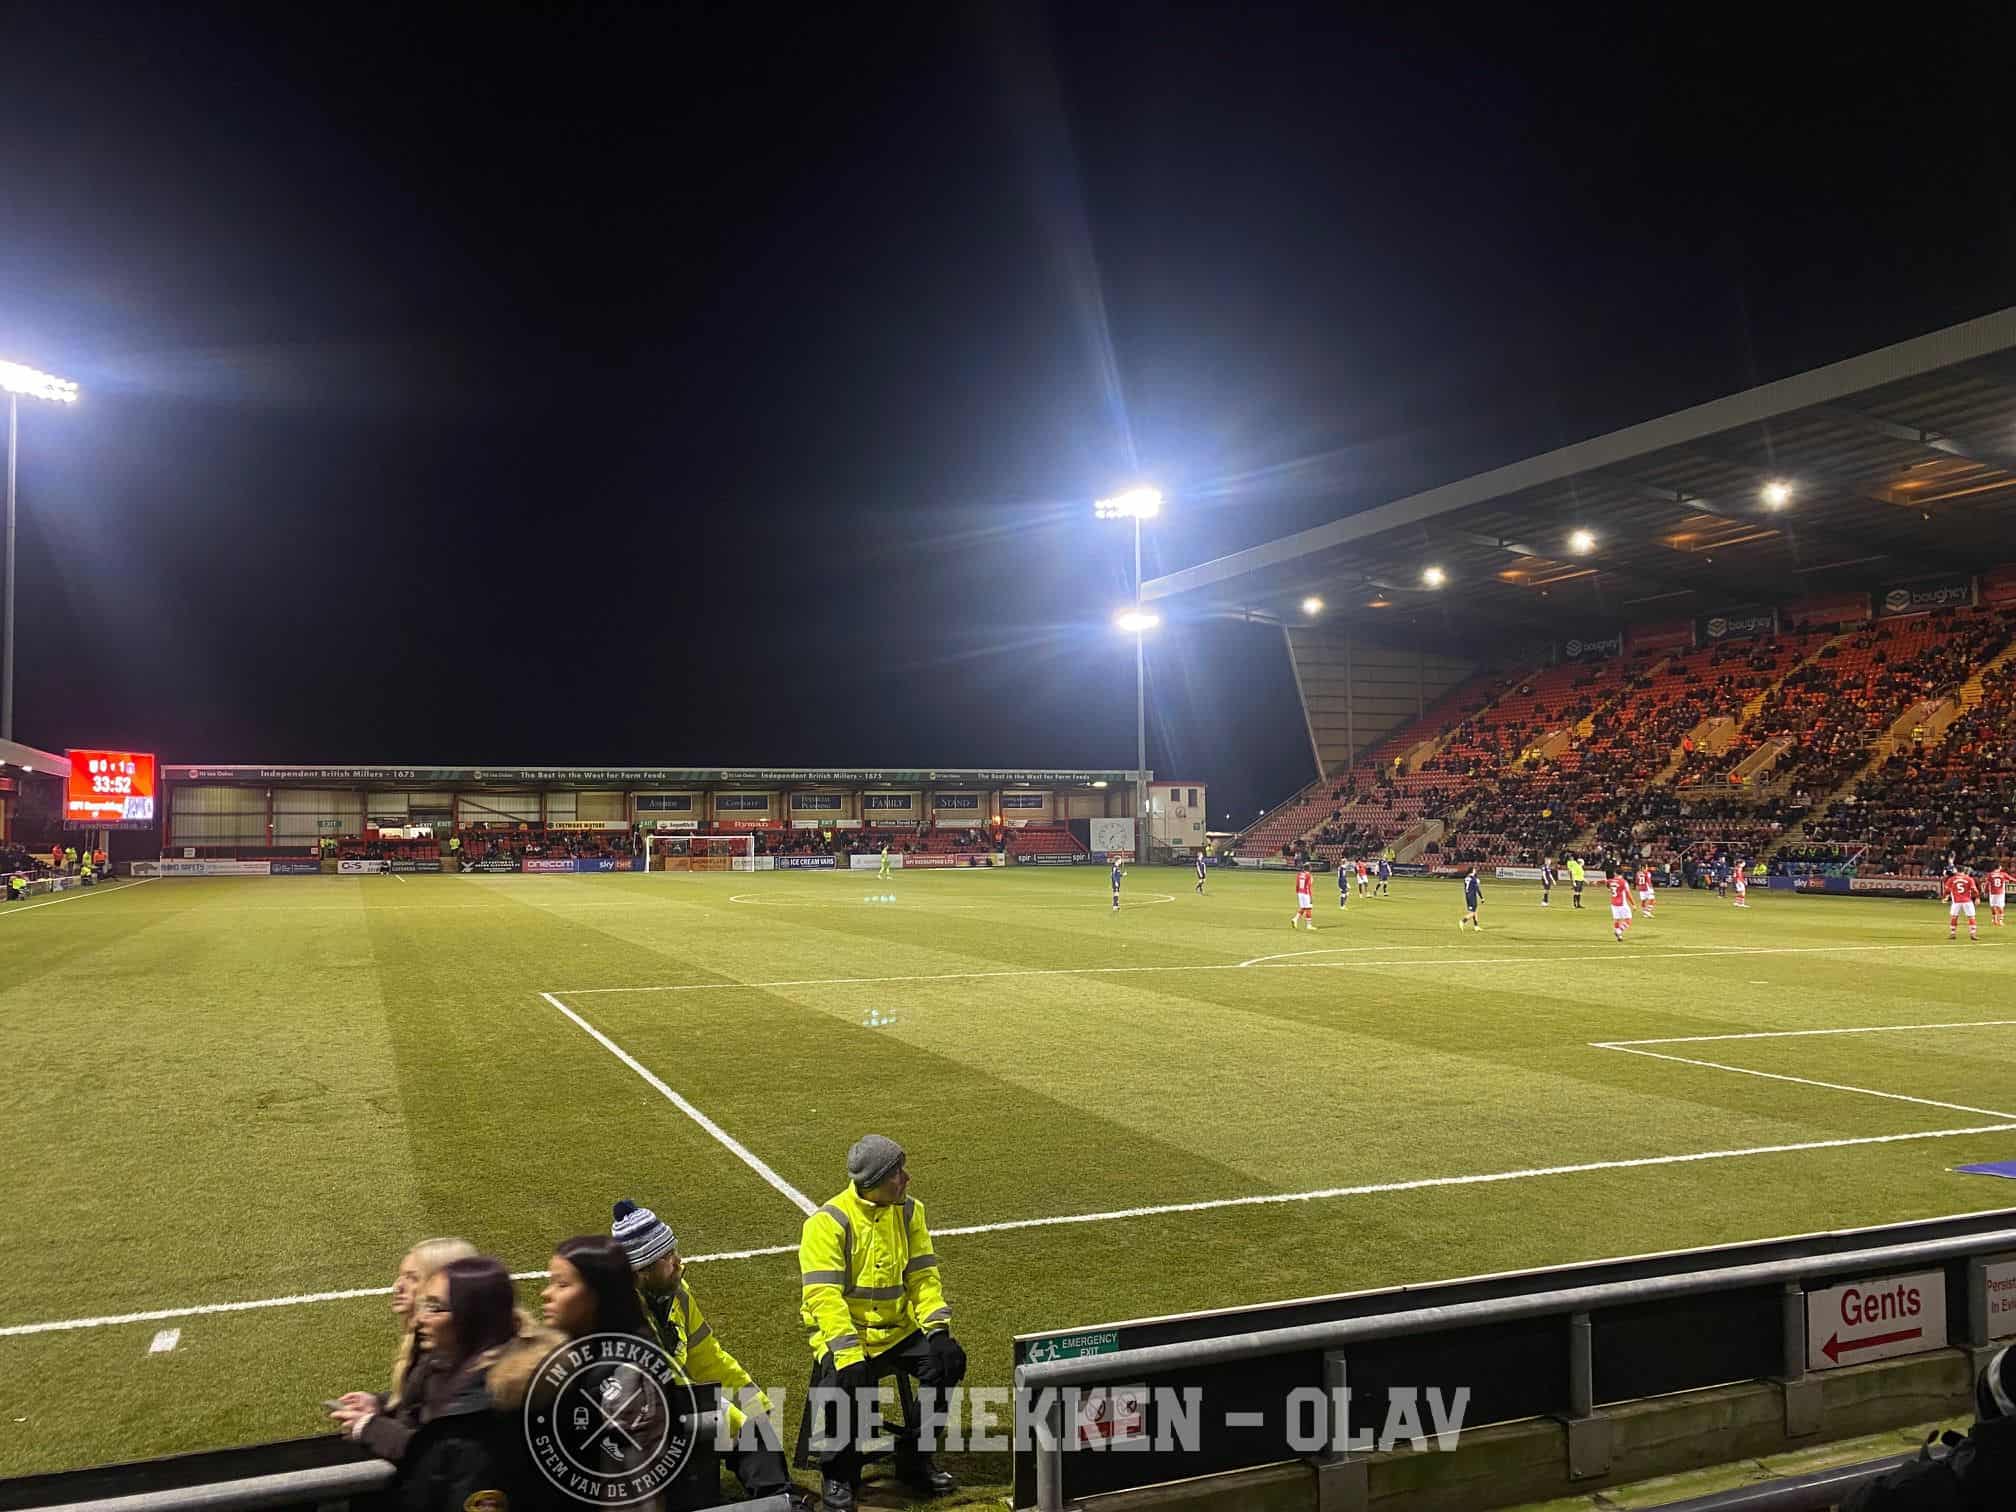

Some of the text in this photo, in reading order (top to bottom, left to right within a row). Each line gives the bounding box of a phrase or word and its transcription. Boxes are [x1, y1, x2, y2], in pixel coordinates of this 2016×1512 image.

[260, 770, 318, 779] Independent
[352, 770, 383, 778] Millers
[761, 772, 807, 780] Independent
[93, 775, 131, 793] 33:52
[872, 796, 903, 808] FAMILY
[942, 799, 970, 808] STAND
[527, 860, 574, 868] onecom
[599, 860, 614, 869] sky
[790, 857, 800, 865] ICE
[800, 857, 820, 865] CREAM
[1794, 879, 1808, 888] sky
[1994, 878, 2002, 887] 8
[1956, 882, 1965, 893] 5
[1840, 1284, 1921, 1326] Gents
[1062, 1332, 1118, 1349] EMERGENCY
[1080, 1347, 1099, 1357] EXIT
